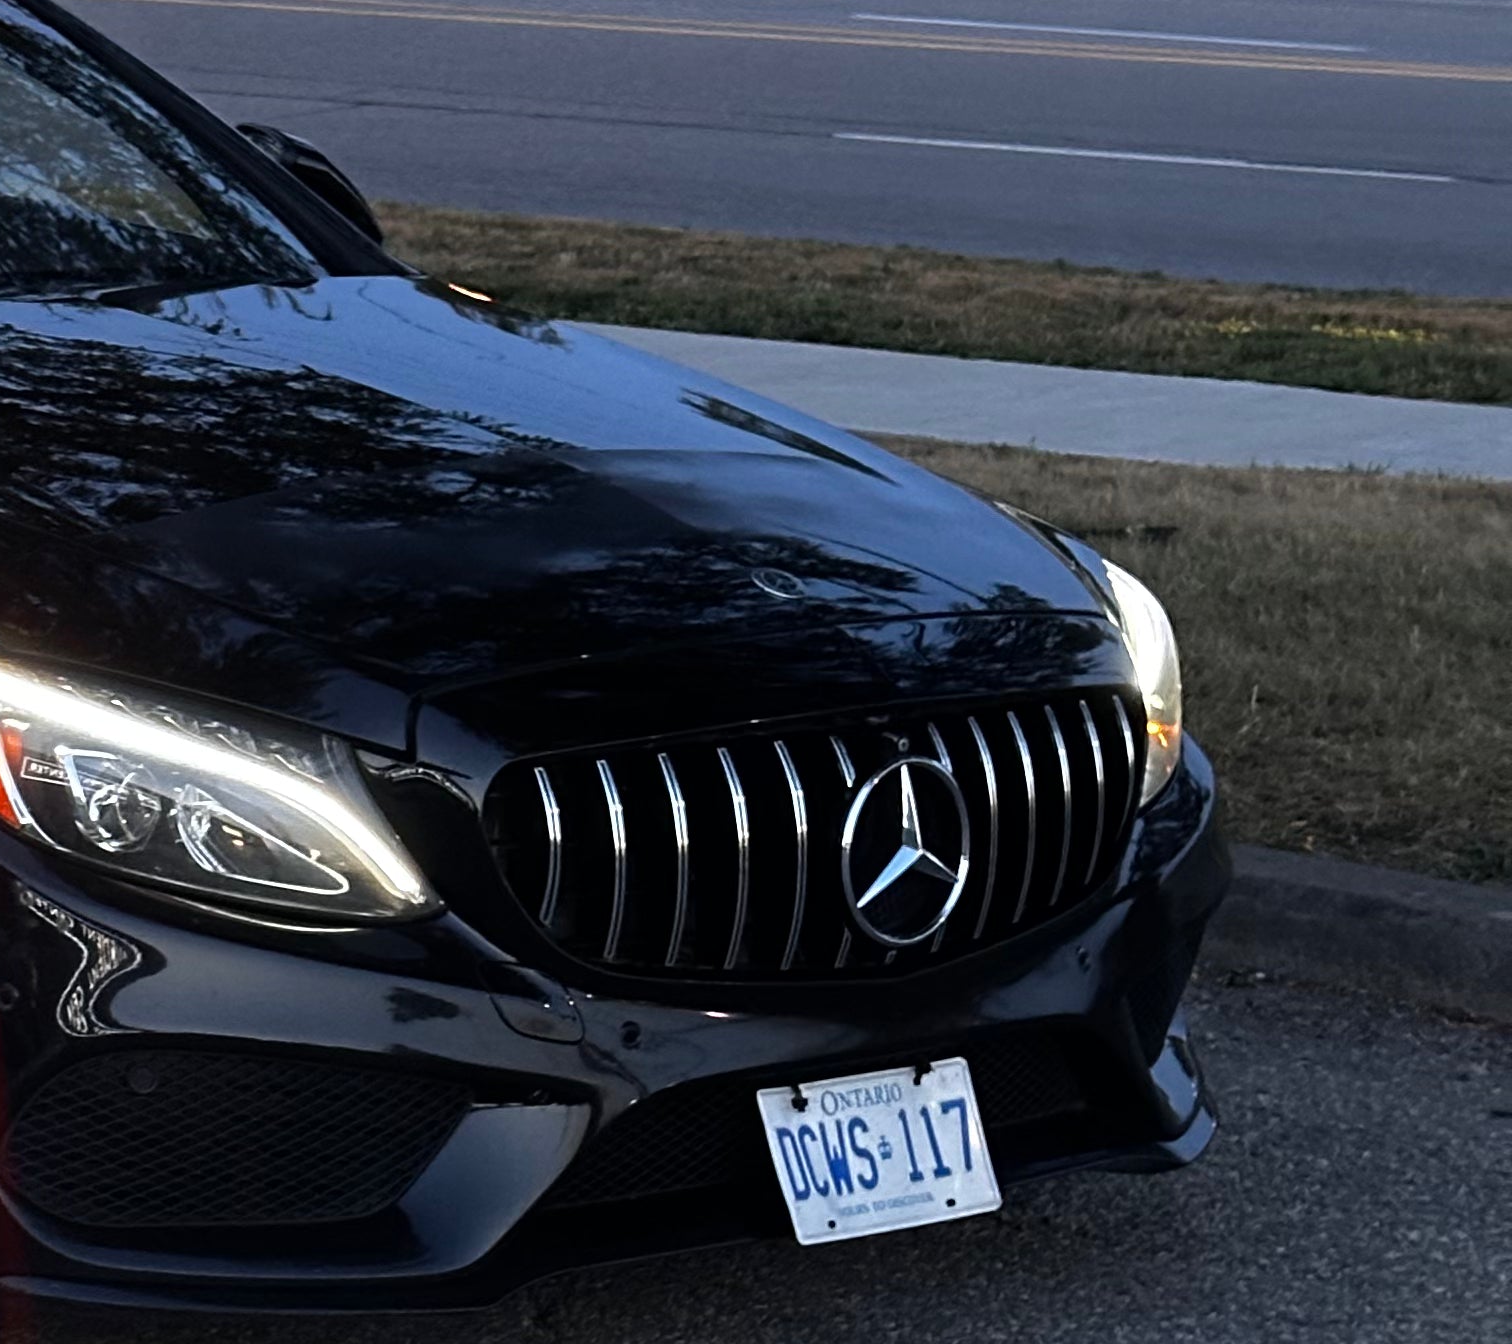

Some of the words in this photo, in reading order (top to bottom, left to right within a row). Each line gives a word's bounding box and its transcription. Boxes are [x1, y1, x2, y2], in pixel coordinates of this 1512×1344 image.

[820, 1083, 903, 1116] ONTARIO
[776, 1116, 879, 1202] DCWS
[898, 1097, 973, 1182] 117
